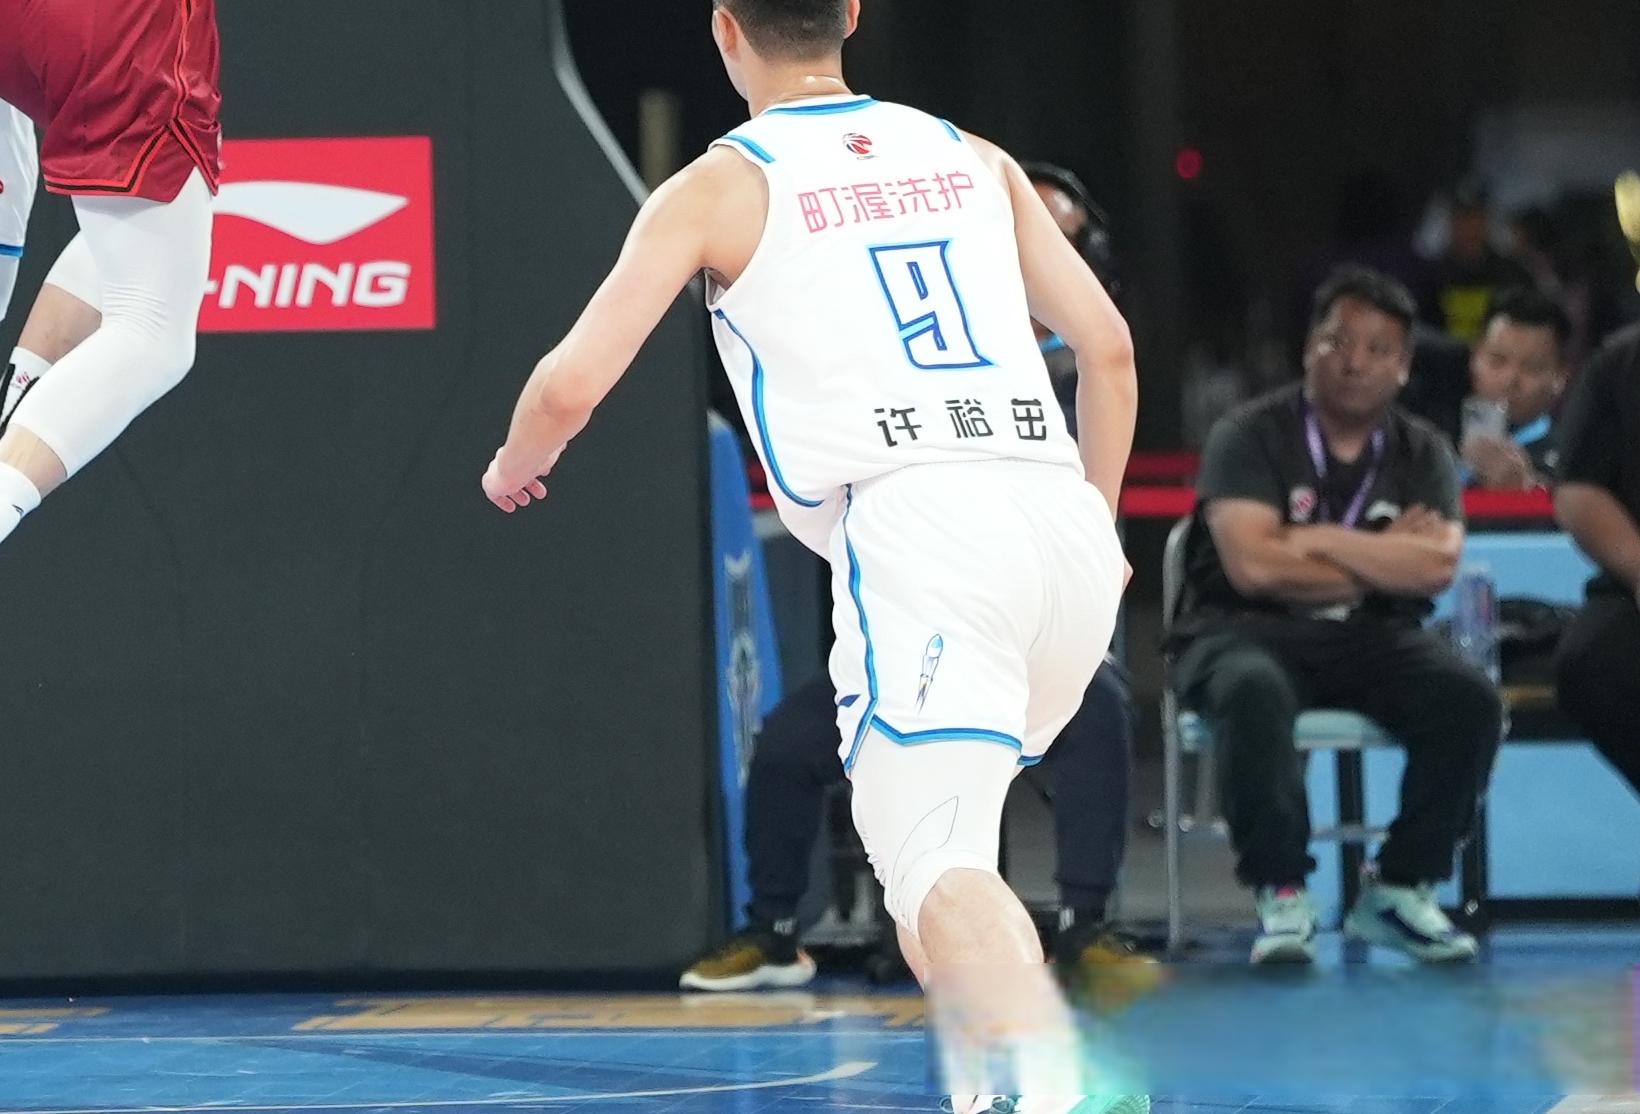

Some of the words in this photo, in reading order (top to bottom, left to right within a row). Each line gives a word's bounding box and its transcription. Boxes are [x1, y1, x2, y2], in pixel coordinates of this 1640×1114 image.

[797, 170, 974, 234] 町渥洗护
[866, 239, 997, 371] 9
